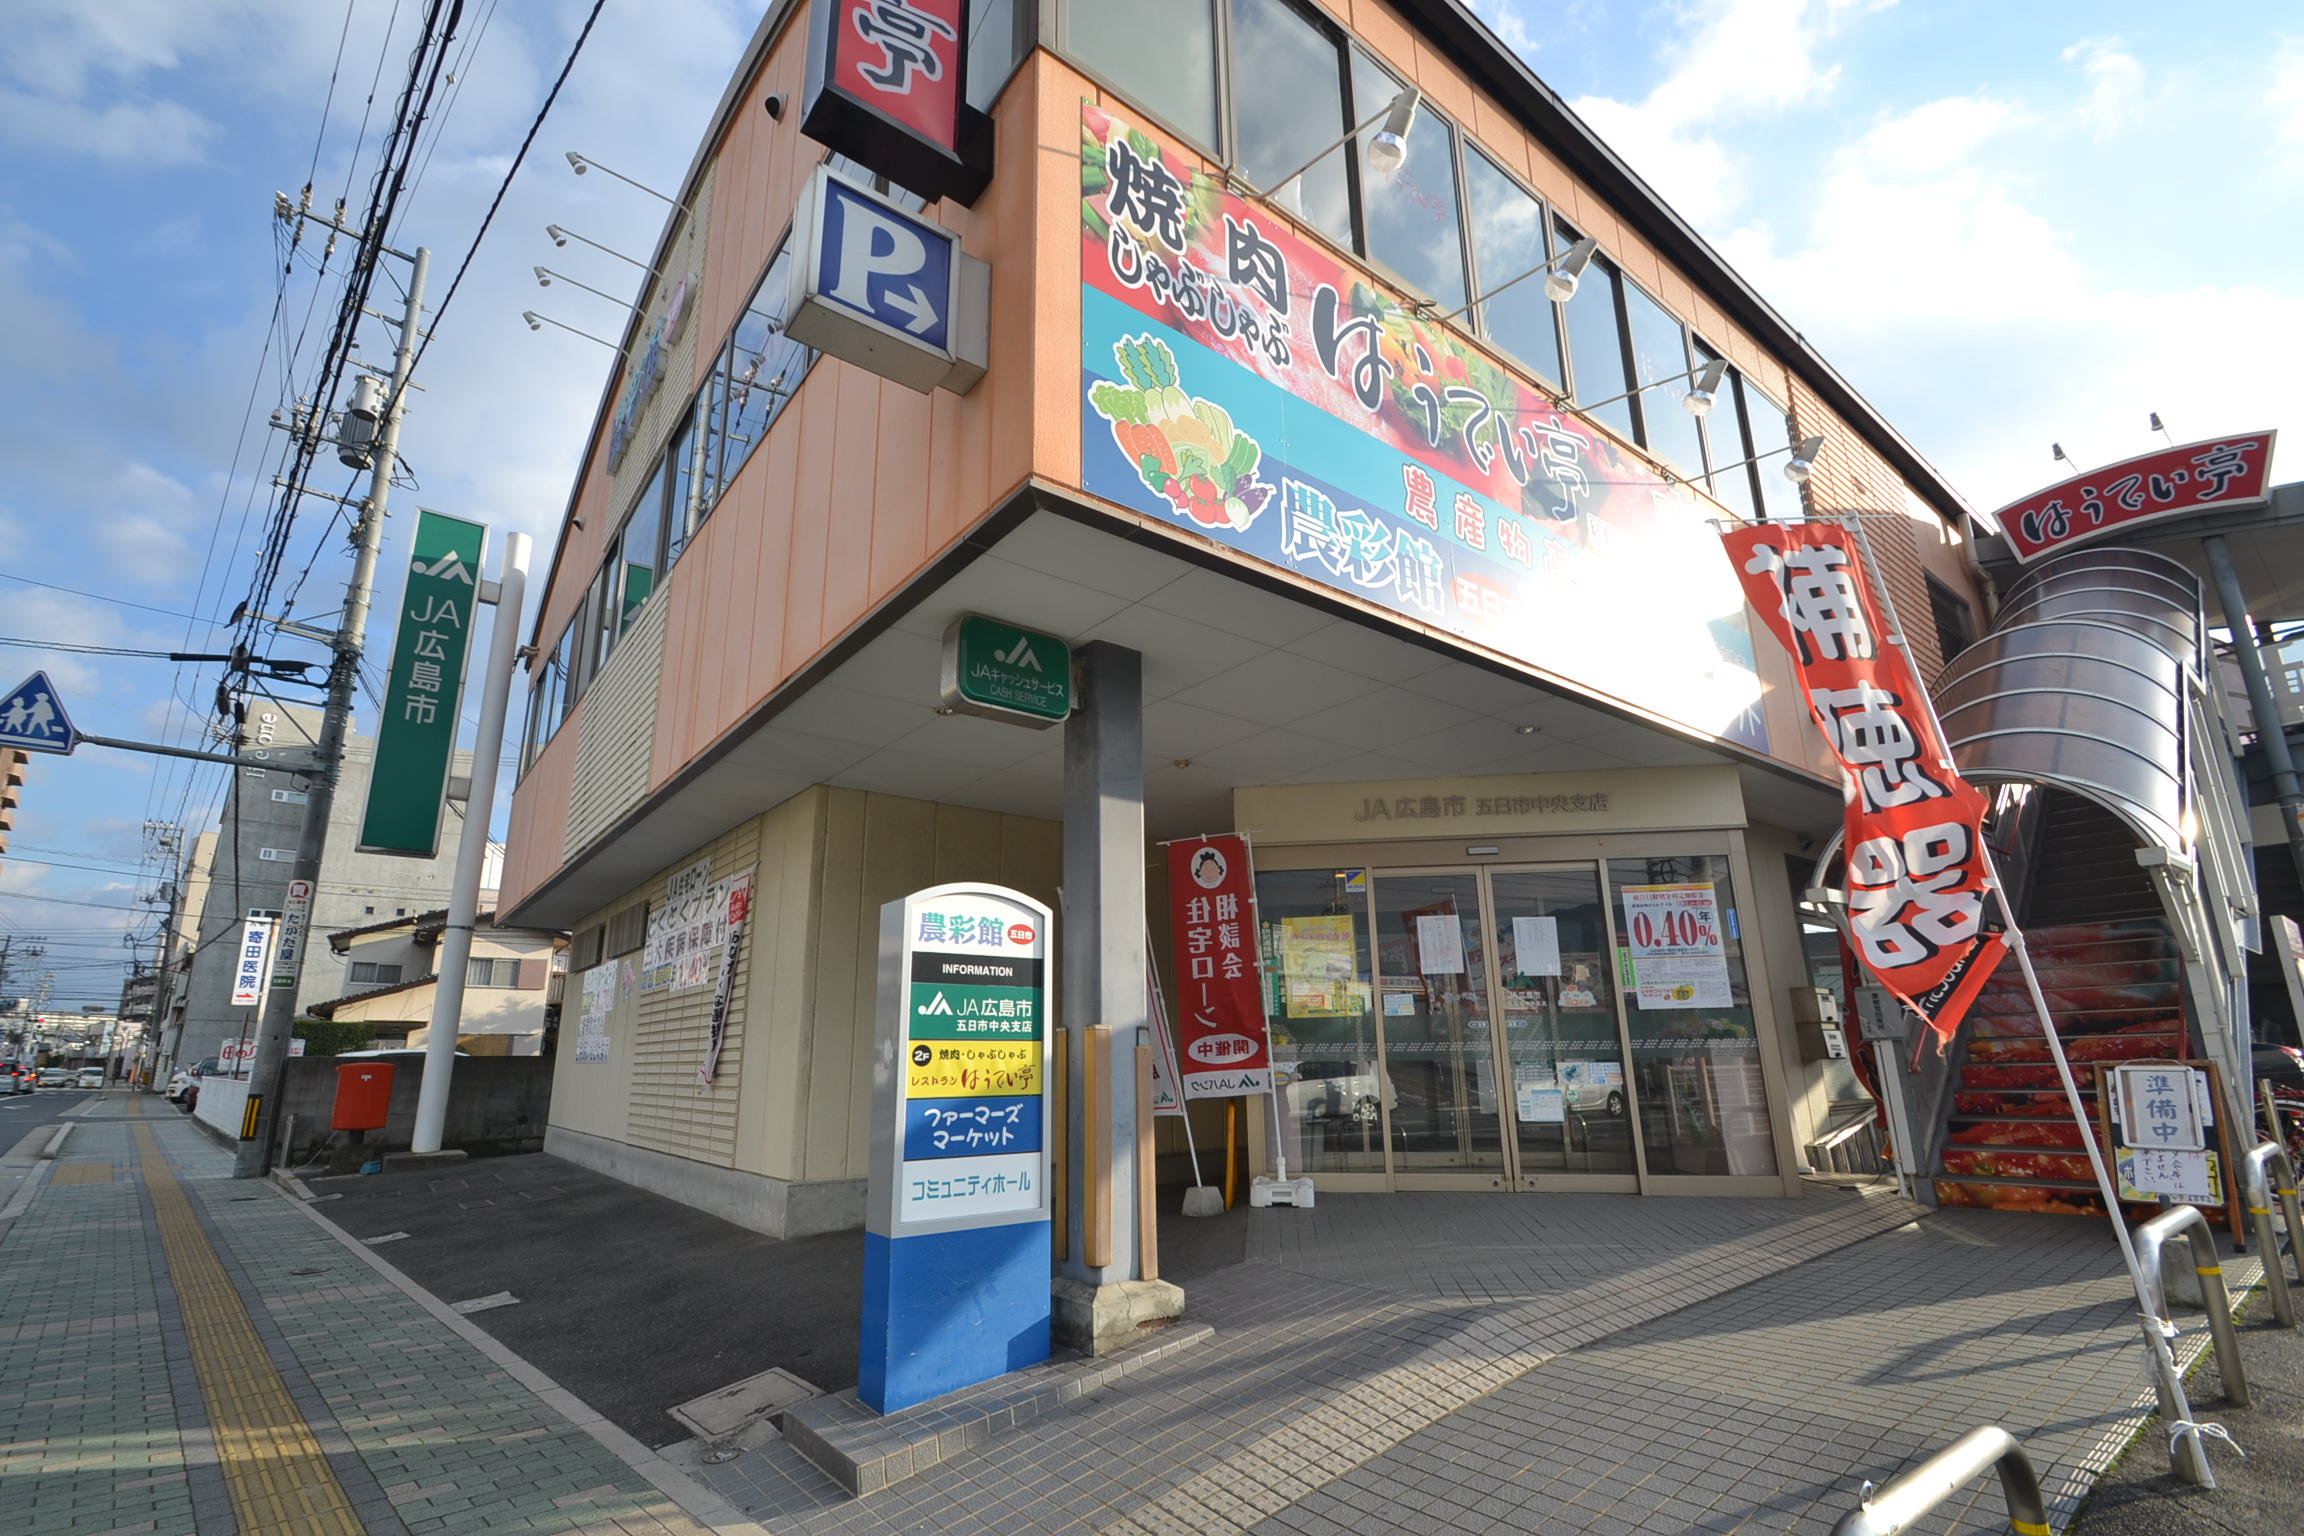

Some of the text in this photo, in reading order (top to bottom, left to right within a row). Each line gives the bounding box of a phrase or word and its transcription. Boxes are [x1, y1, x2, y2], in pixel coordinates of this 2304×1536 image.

[1107, 139, 1289, 317] 焼肉
[828, 196, 926, 314] P
[1110, 219, 1291, 368] しゃぶしゃぶ
[1281, 482, 1444, 617] 農彩館
[404, 595, 461, 725] JA広島市
[970, 662, 1064, 697] JAキャッシュサービス
[990, 684, 1047, 708] CASH SERVICE
[1354, 794, 1466, 822] JA広島市
[918, 911, 1005, 947] 農彩館
[239, 930, 265, 989] 寄田医院
[942, 963, 1014, 977] INFORMATION
[956, 997, 1033, 1018] JA広島市
[956, 1019, 1033, 1033] 五日市中央支店
[913, 1050, 931, 1061] 2F
[911, 1075, 958, 1087] レストラン
[923, 1103, 1024, 1128] ファーマーズ
[2145, 1075, 2179, 1143] 準備中
[932, 1124, 1015, 1150] マーケット
[911, 1171, 1032, 1202] コミュニティホール
